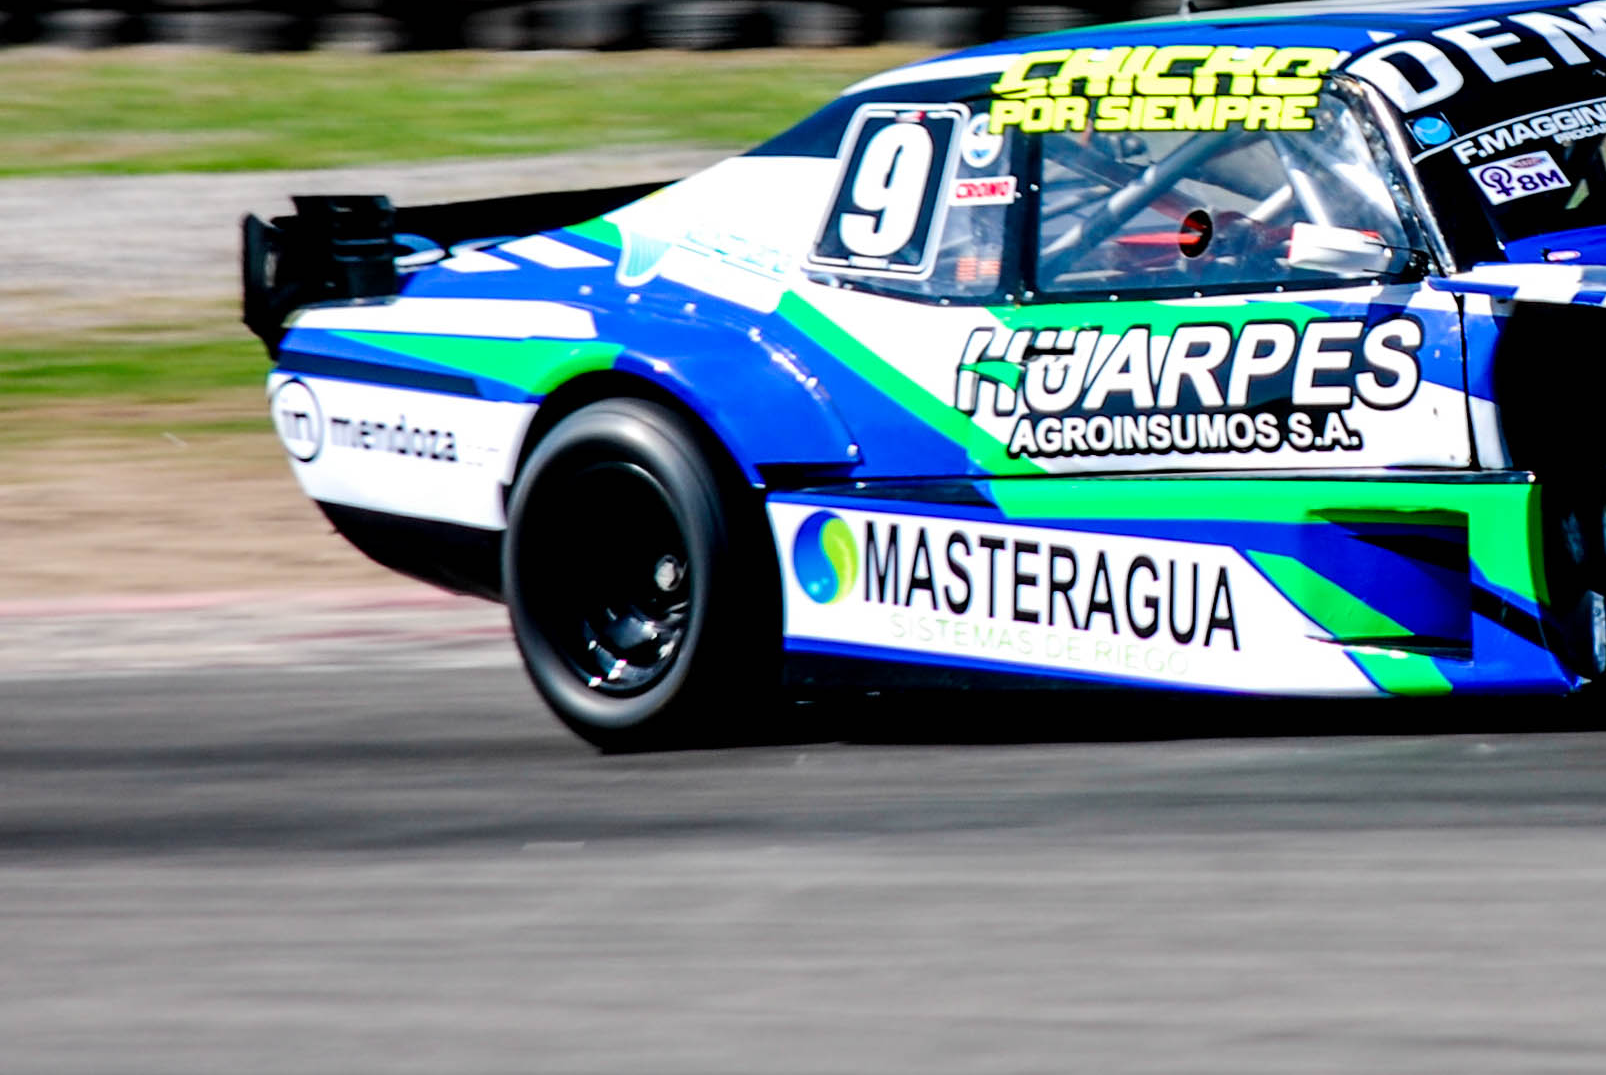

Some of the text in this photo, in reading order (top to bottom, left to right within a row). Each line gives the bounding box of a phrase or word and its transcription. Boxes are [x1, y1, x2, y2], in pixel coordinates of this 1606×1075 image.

[991, 45, 1340, 99] CHICHO
[988, 95, 1319, 134] POR SIEMPRE
[839, 121, 934, 257] 9
[1517, 169, 1564, 192] 8M
[956, 318, 1423, 416] HUARPES
[331, 414, 459, 462] mendoza
[1006, 410, 1363, 458] AGROINSUMOS S.A.
[863, 521, 1241, 652] MASTERAGUA
[889, 612, 1190, 676] SISTEMAS DE RIEGO
